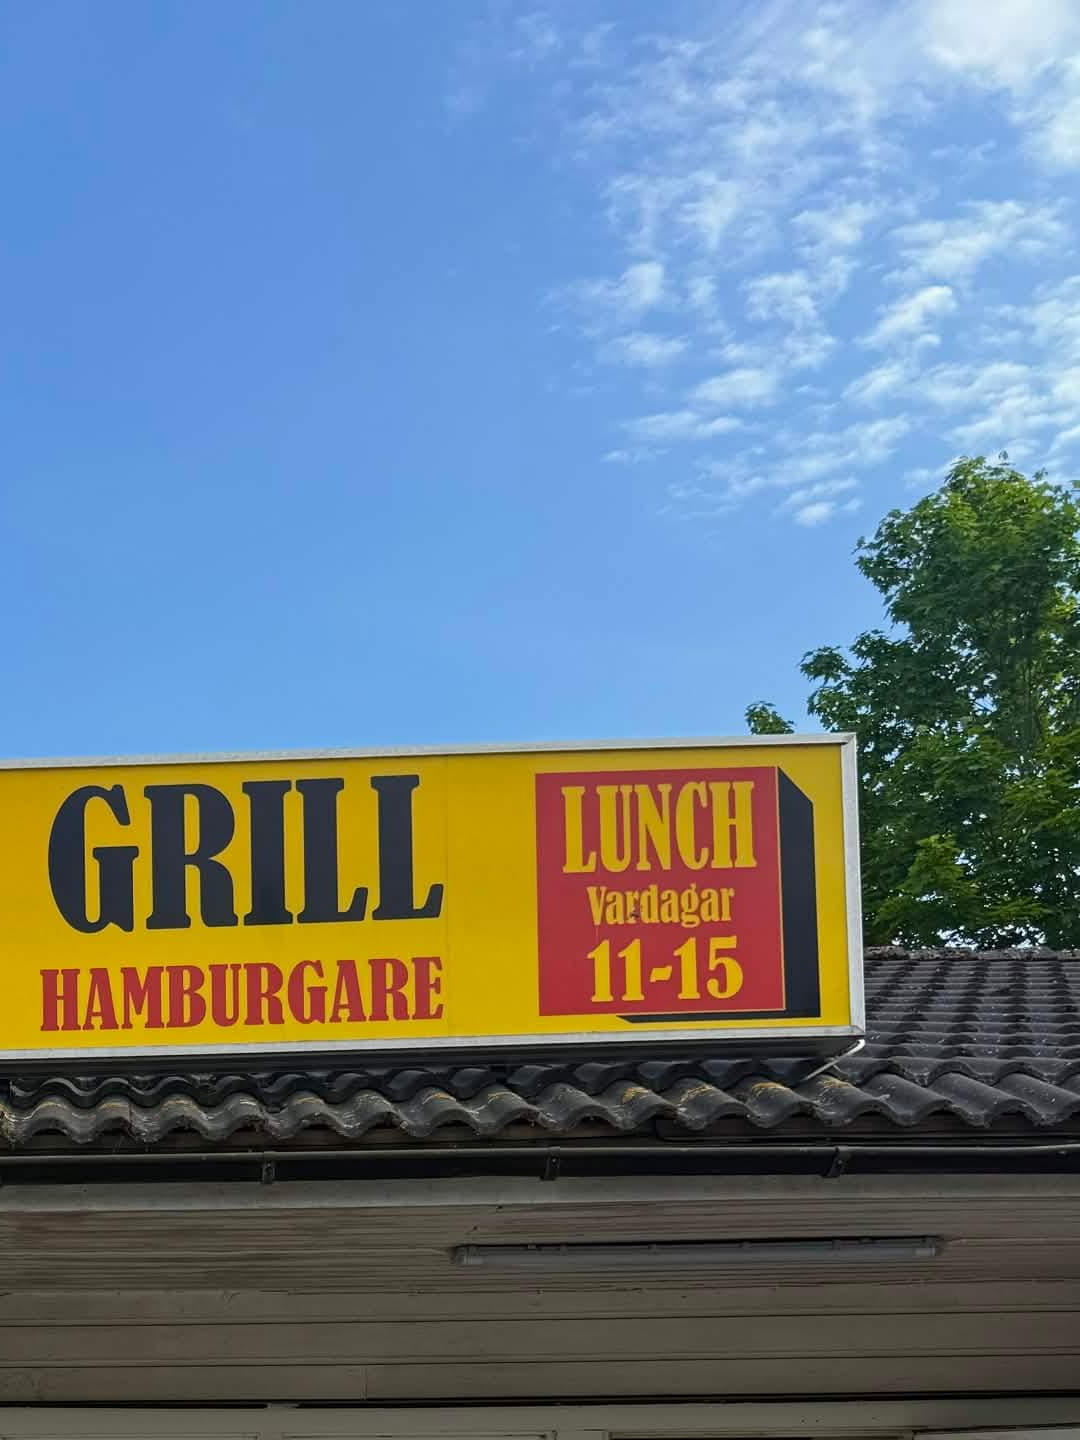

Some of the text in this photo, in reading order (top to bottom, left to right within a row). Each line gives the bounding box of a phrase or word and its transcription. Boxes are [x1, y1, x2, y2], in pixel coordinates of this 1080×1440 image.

[48, 774, 445, 934] GRILL
[561, 781, 758, 874] LUNCH
[585, 883, 735, 929] Vardagar
[39, 957, 445, 1032] HAMBURGARE
[586, 935, 743, 1003] 11-15
